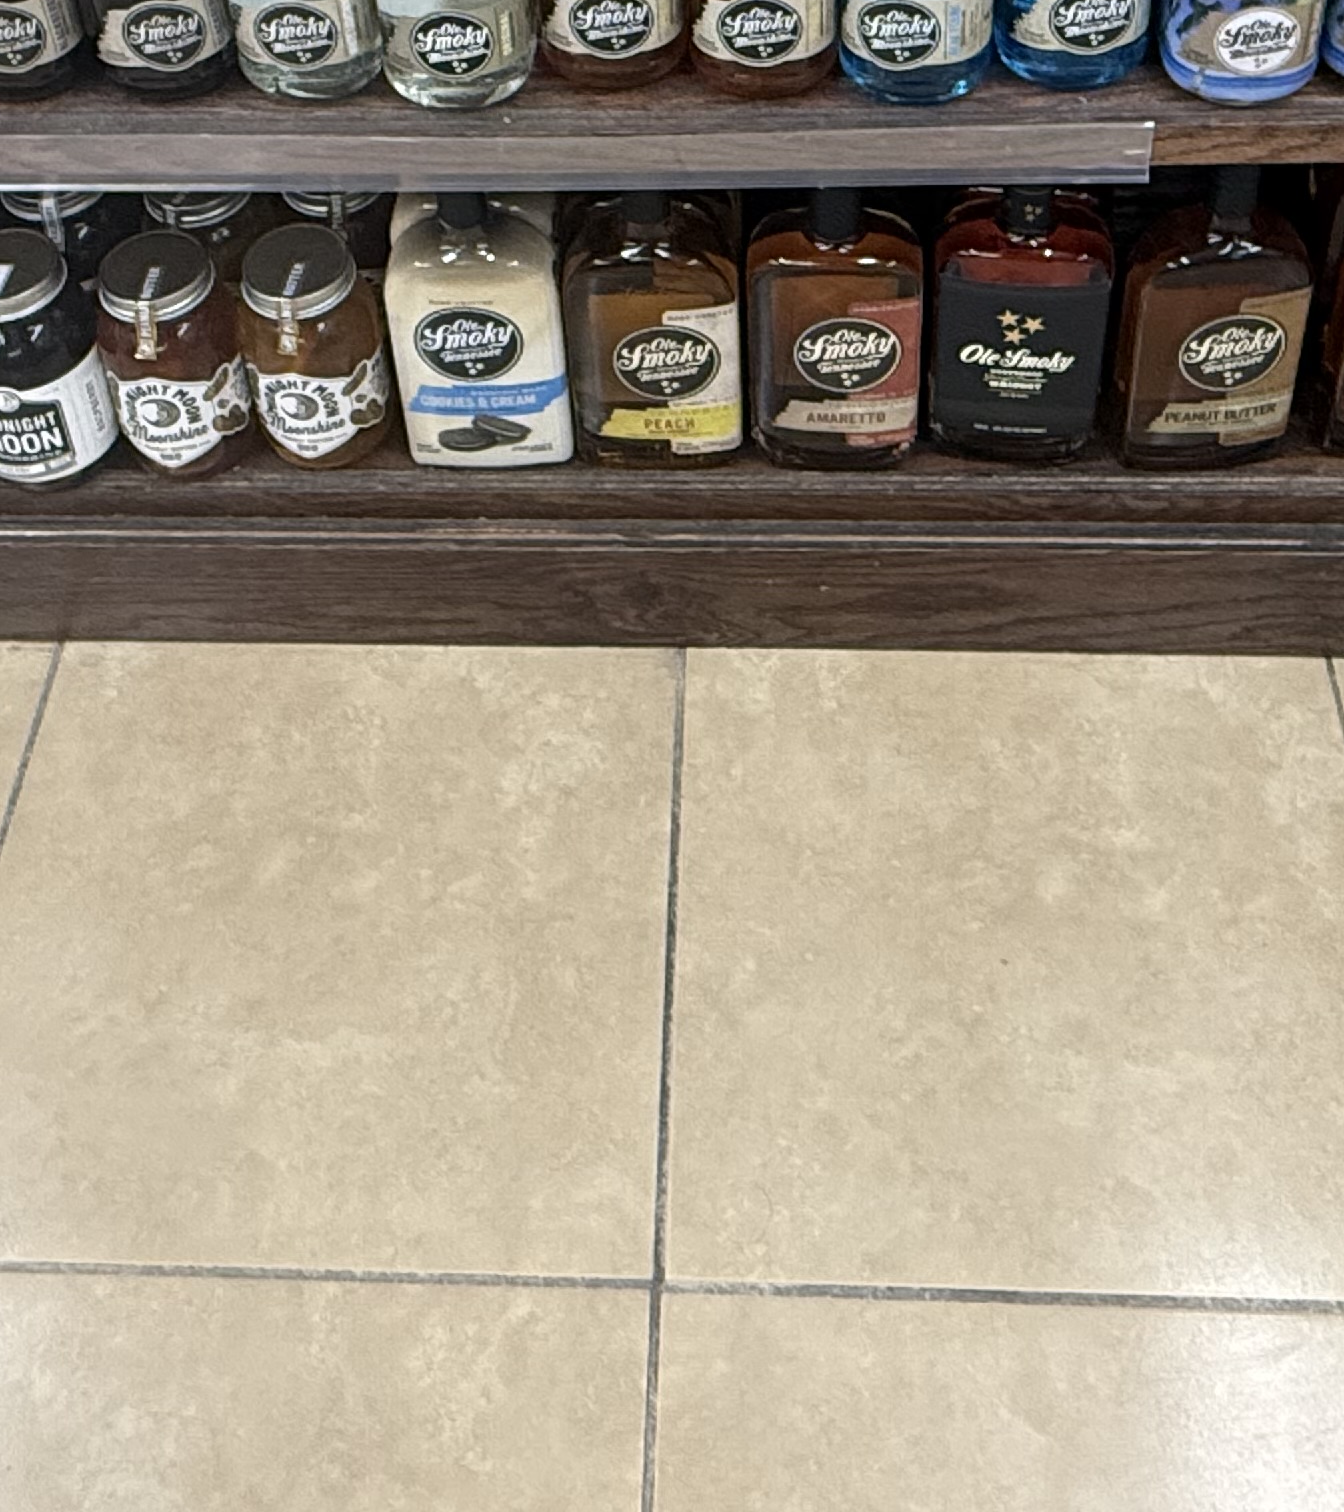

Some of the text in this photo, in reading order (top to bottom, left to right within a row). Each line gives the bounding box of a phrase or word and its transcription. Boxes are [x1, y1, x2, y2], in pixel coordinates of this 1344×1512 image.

[575, 3, 648, 29] Smoky
[722, 10, 797, 36] Smoky
[862, 17, 934, 40] Smoky
[130, 18, 197, 44] Smoky
[261, 18, 329, 44] Smoky
[417, 28, 486, 53] Smoky
[1223, 24, 1298, 48] Smoky
[421, 323, 511, 352] Smoky
[798, 334, 895, 364] Smoky
[1184, 331, 1281, 363] Smoky
[618, 343, 711, 370] Smoky
[959, 344, 1075, 373] Ole Smoky
[175, 389, 203, 424] MOON
[315, 382, 340, 418] MOON
[420, 393, 536, 409] COOKIES & CREAM
[269, 417, 345, 435] Moonshine
[644, 417, 695, 432] PEACH
[807, 410, 886, 426] AMARETTO
[1165, 403, 1277, 424] PEANUT BUTTER
[131, 423, 208, 444] Moonshine
